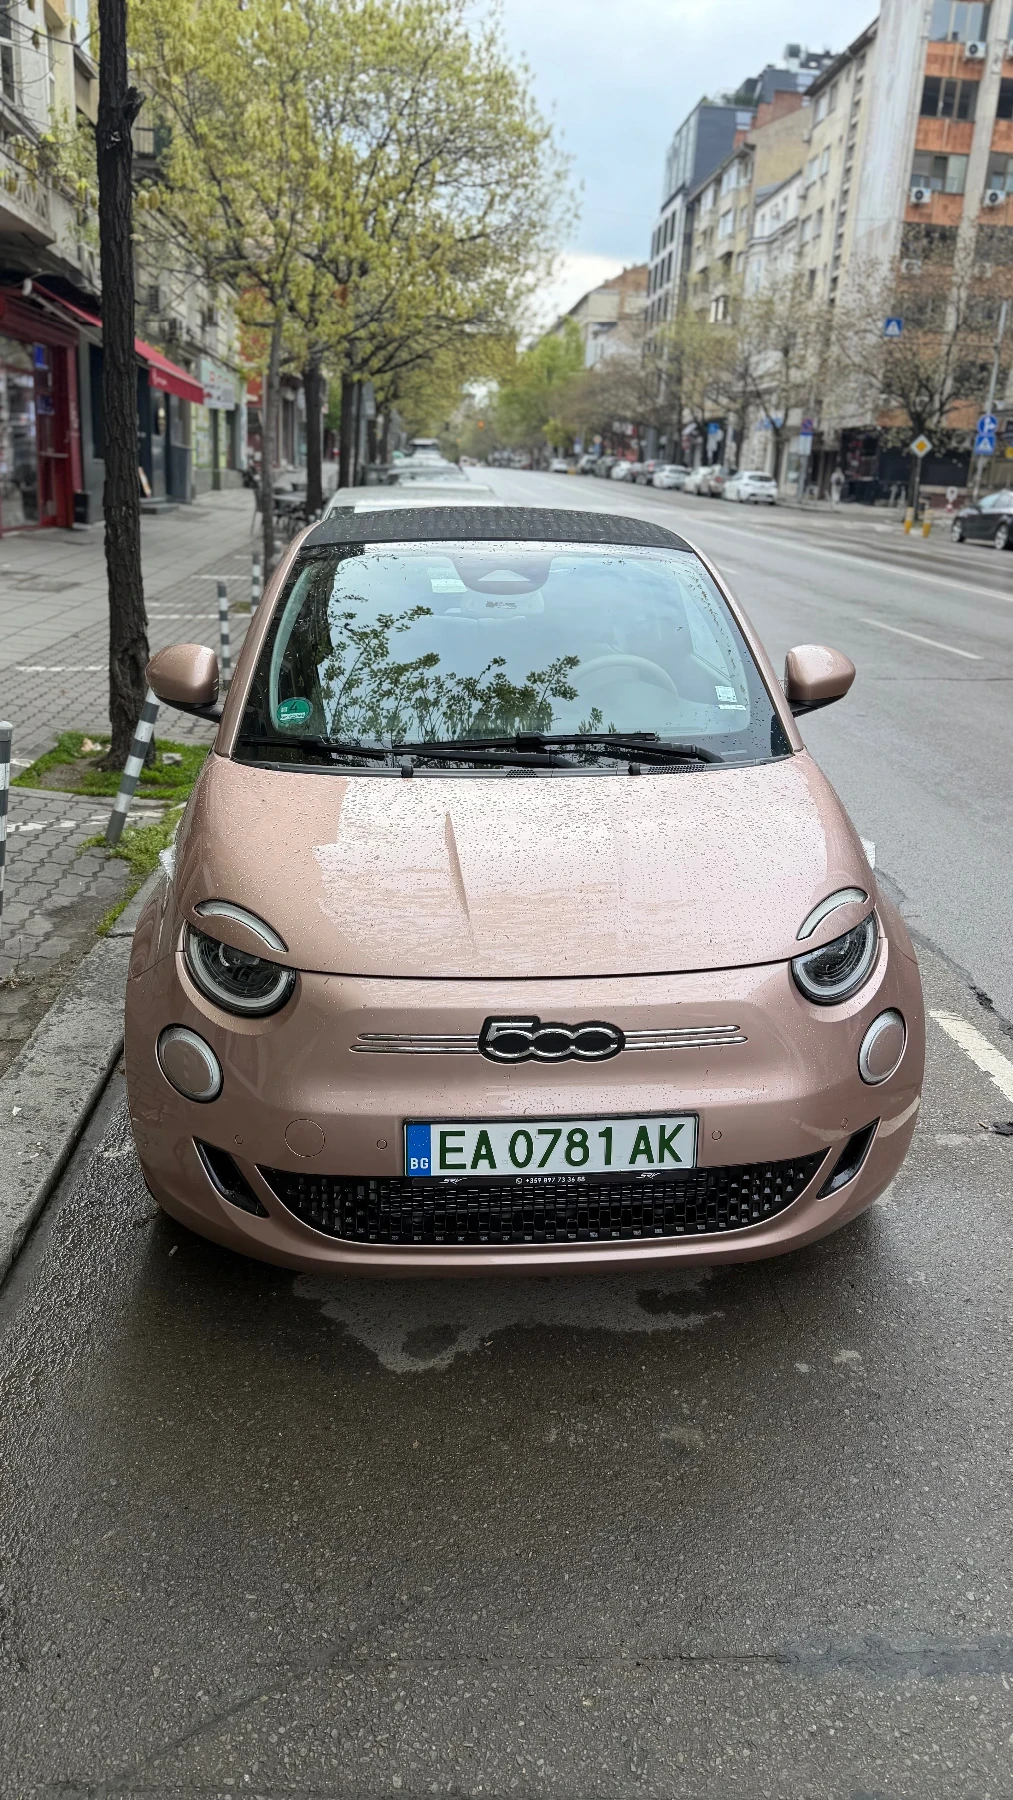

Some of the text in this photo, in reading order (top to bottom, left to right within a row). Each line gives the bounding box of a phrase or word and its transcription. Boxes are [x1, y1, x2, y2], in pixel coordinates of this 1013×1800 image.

[289, 701, 298, 712] 4
[486, 1022, 618, 1058] 500
[439, 1123, 685, 1170] EA 0781 AK
[410, 1157, 429, 1170] BG
